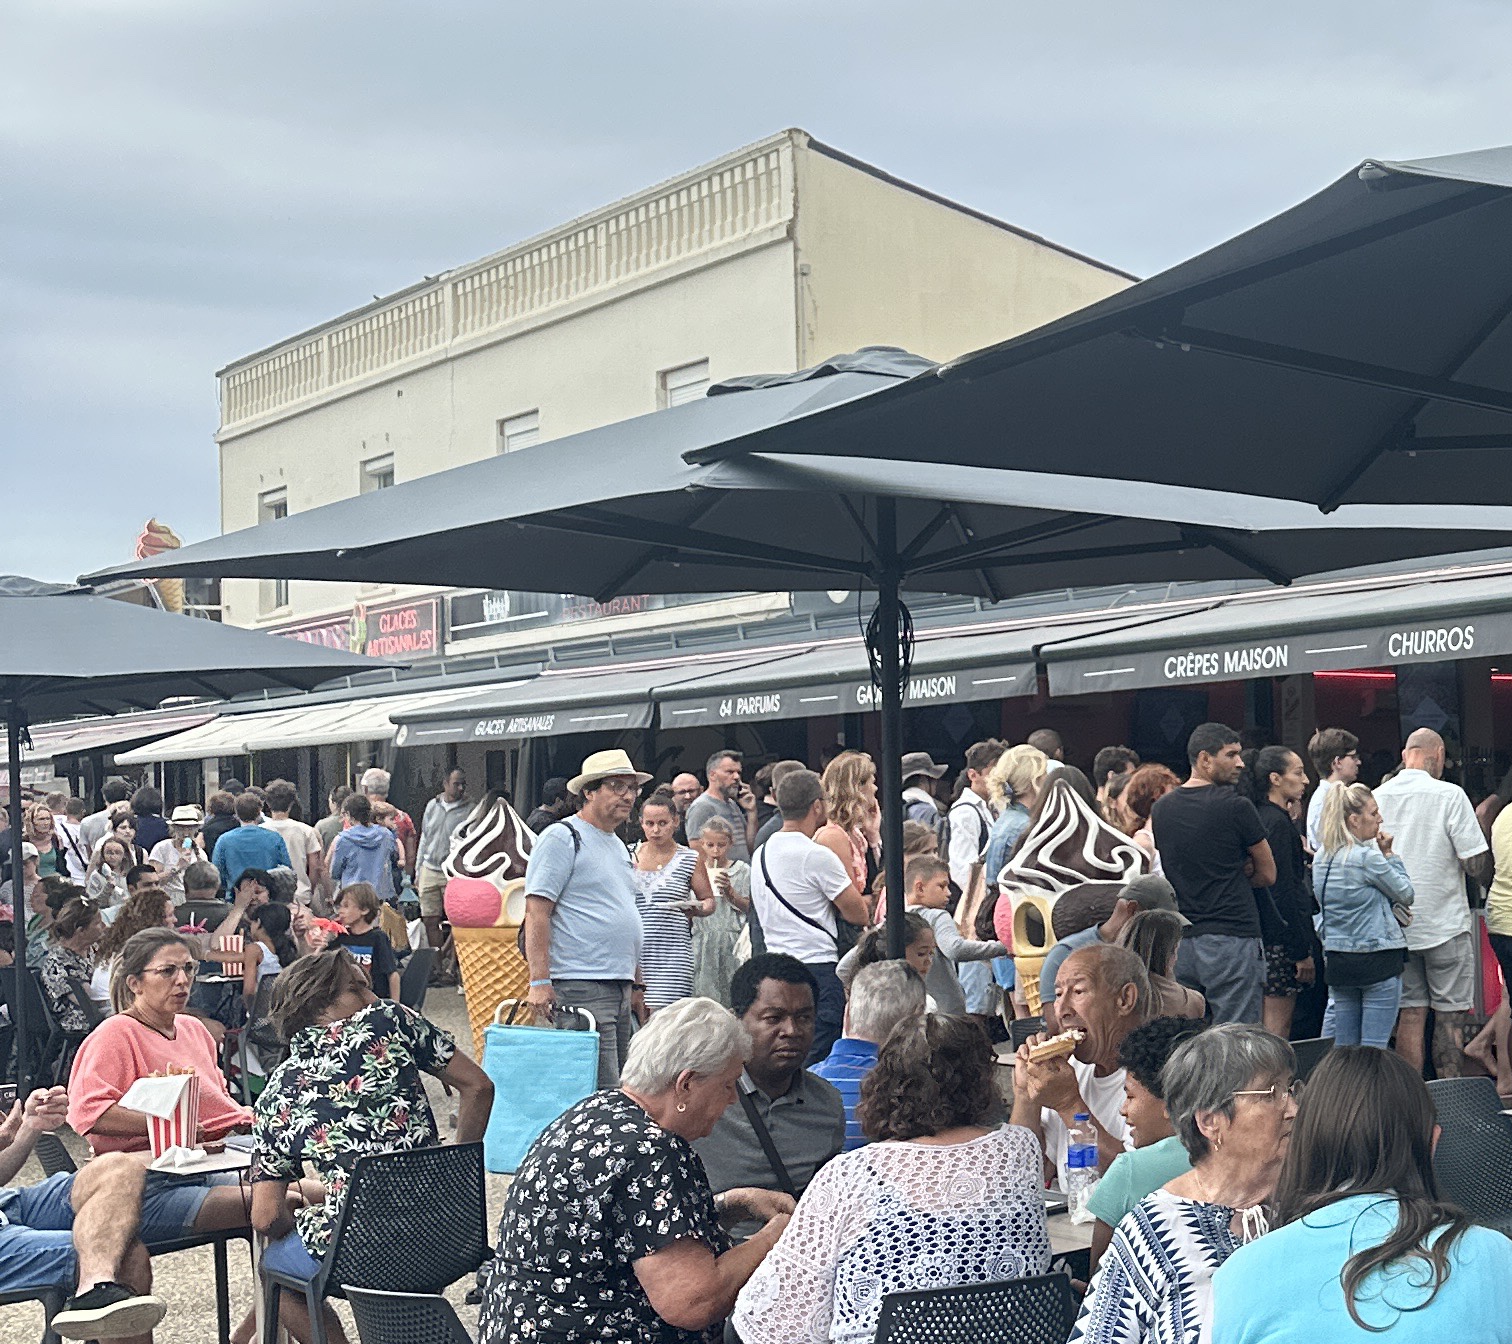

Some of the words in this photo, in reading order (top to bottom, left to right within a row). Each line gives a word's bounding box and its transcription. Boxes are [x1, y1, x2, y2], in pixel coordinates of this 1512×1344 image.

[379, 609, 417, 634] GLACES
[1388, 625, 1475, 657] CHURROS
[1164, 652, 1219, 679] CRÊPES
[1223, 645, 1288, 674] MAISON
[909, 676, 956, 700] MAISON
[719, 699, 732, 717] 64
[736, 694, 780, 715] PARFUMS
[474, 719, 505, 736] GLACES
